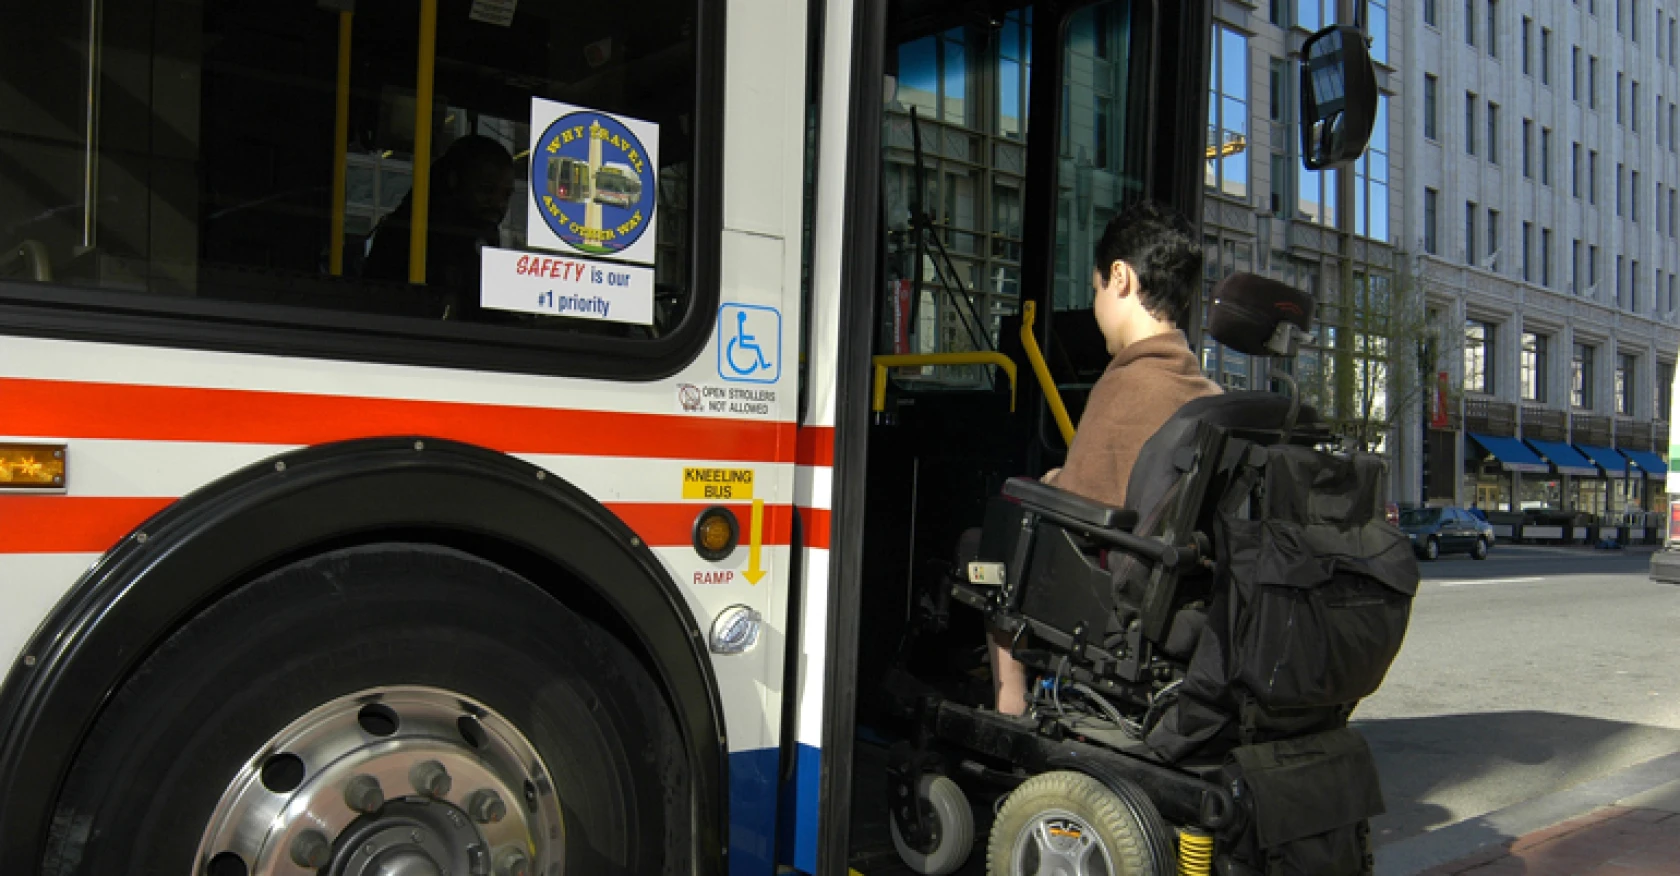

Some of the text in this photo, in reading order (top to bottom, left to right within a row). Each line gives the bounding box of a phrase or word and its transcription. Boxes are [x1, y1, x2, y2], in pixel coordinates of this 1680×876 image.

[546, 125, 644, 173] WHY TRAVEL
[543, 195, 643, 241] ANY OTHER WAY
[516, 255, 631, 287] SAFETY is our
[538, 289, 611, 316] #1 priority
[702, 386, 776, 402] OPEN STROLLERS
[708, 400, 727, 412] NOT
[728, 402, 769, 414] ALLOWED
[684, 468, 752, 483] KNEELING
[704, 485, 732, 499] BUS
[693, 570, 734, 585] RAMP
